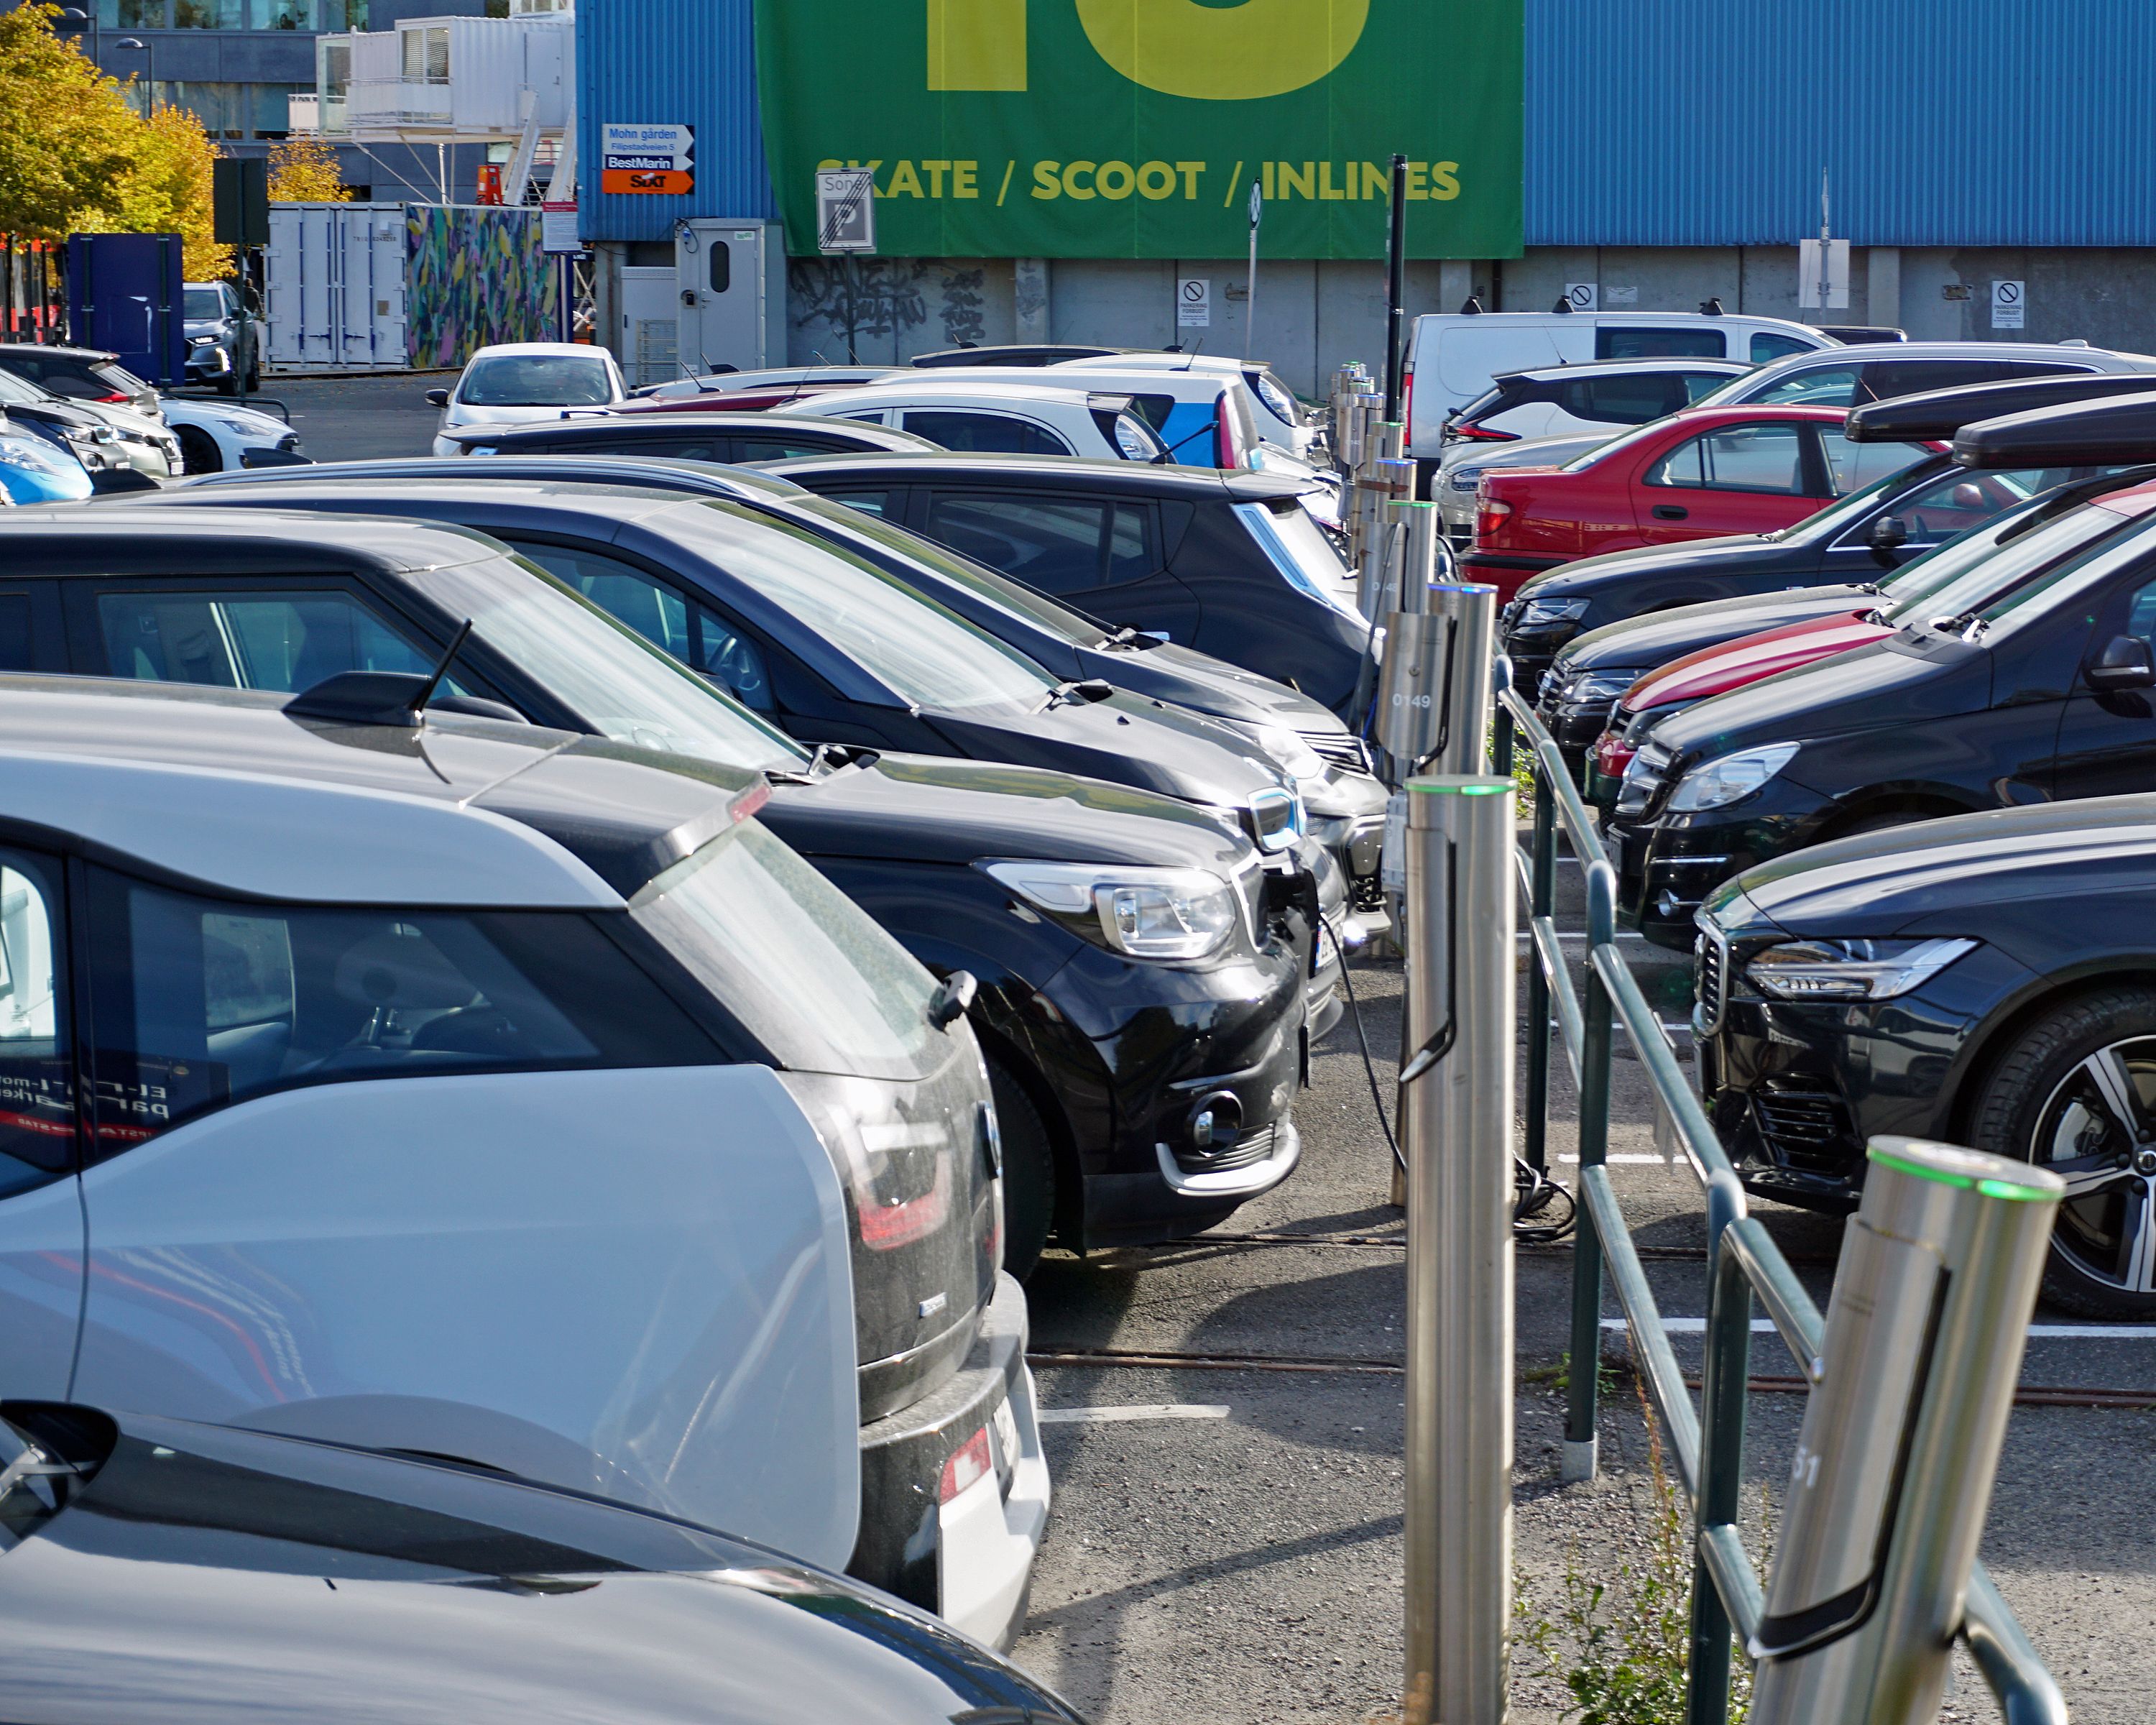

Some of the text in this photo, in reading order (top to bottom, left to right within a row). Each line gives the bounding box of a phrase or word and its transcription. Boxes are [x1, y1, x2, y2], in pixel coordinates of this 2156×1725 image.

[609, 128, 677, 141] Mohn gården
[608, 157, 671, 169] BestMarin
[824, 177, 862, 191] Sone
[1031, 160, 1206, 201] SCOOT
[1263, 160, 1461, 201] INLINES
[1392, 693, 1431, 708] 0149
